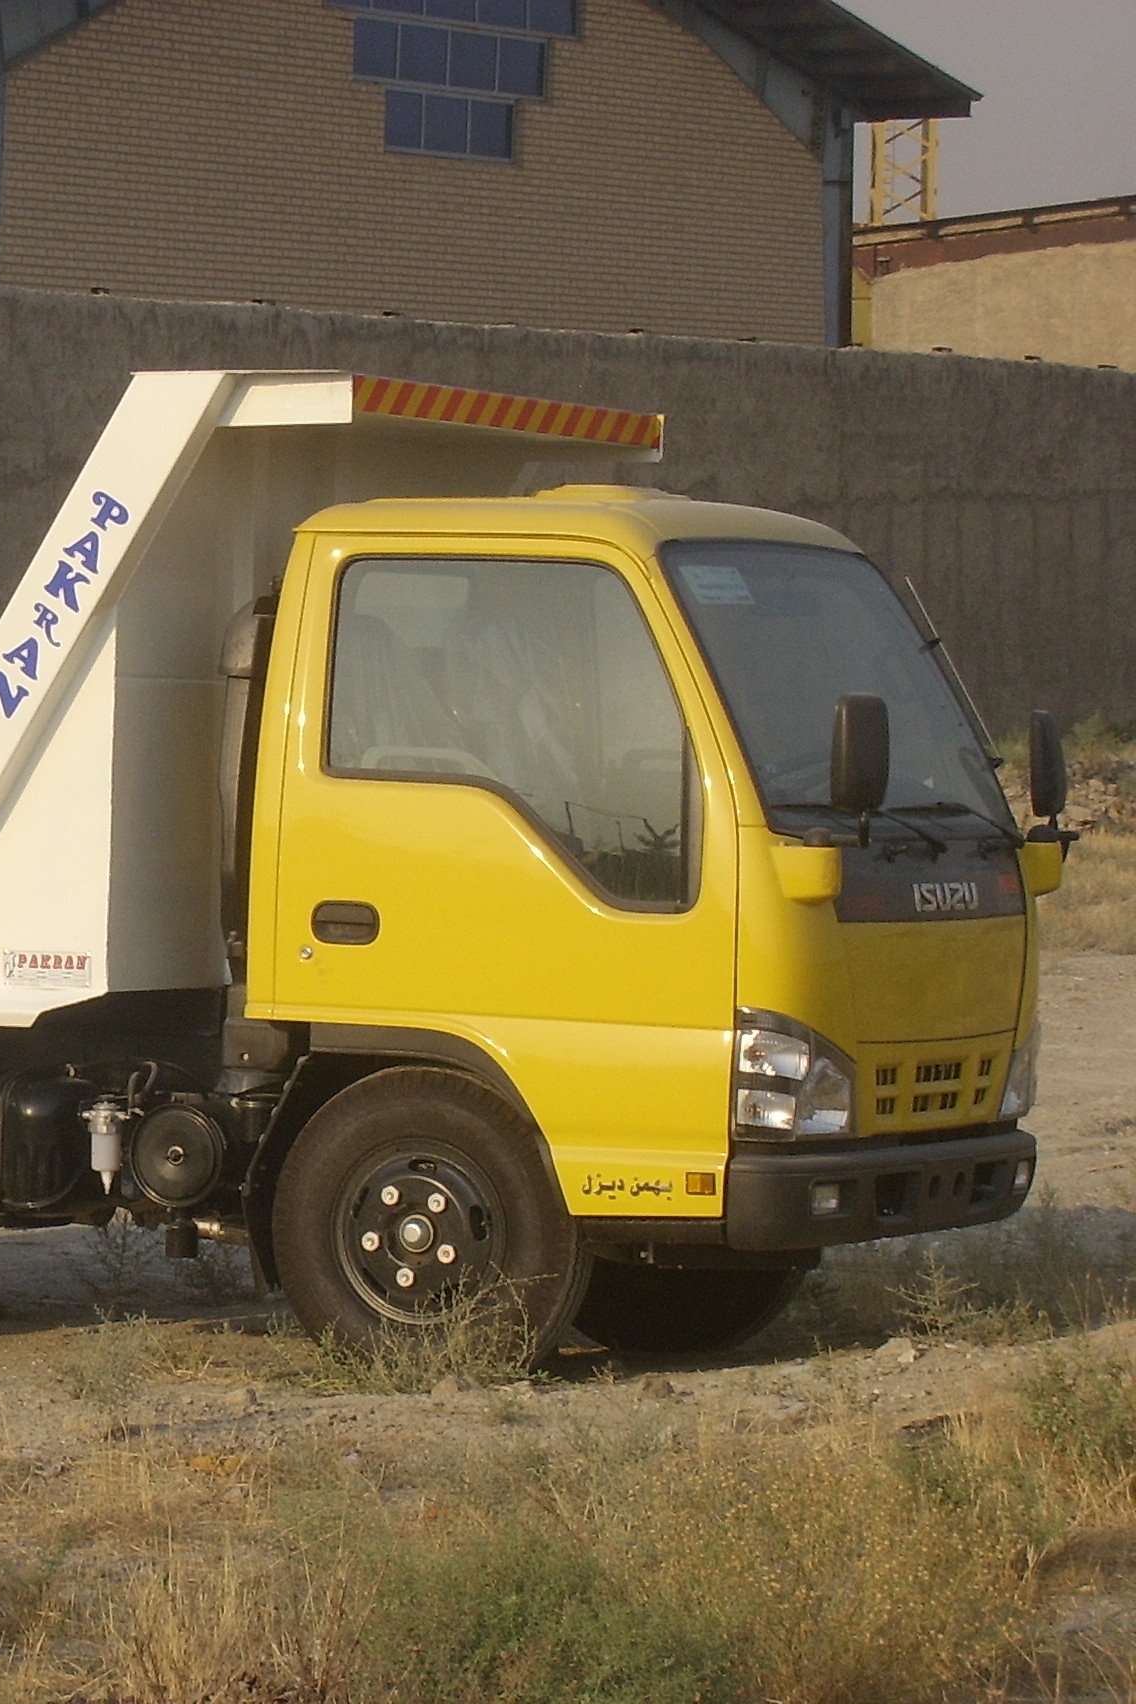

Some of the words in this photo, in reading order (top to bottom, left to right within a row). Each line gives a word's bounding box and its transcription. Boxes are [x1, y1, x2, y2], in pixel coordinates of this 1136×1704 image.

[912, 881, 979, 912] ISUZU
[17, 953, 88, 970] PAKRAN
[581, 1173, 625, 1200] دیزل
[629, 1176, 673, 1201] بهمن
